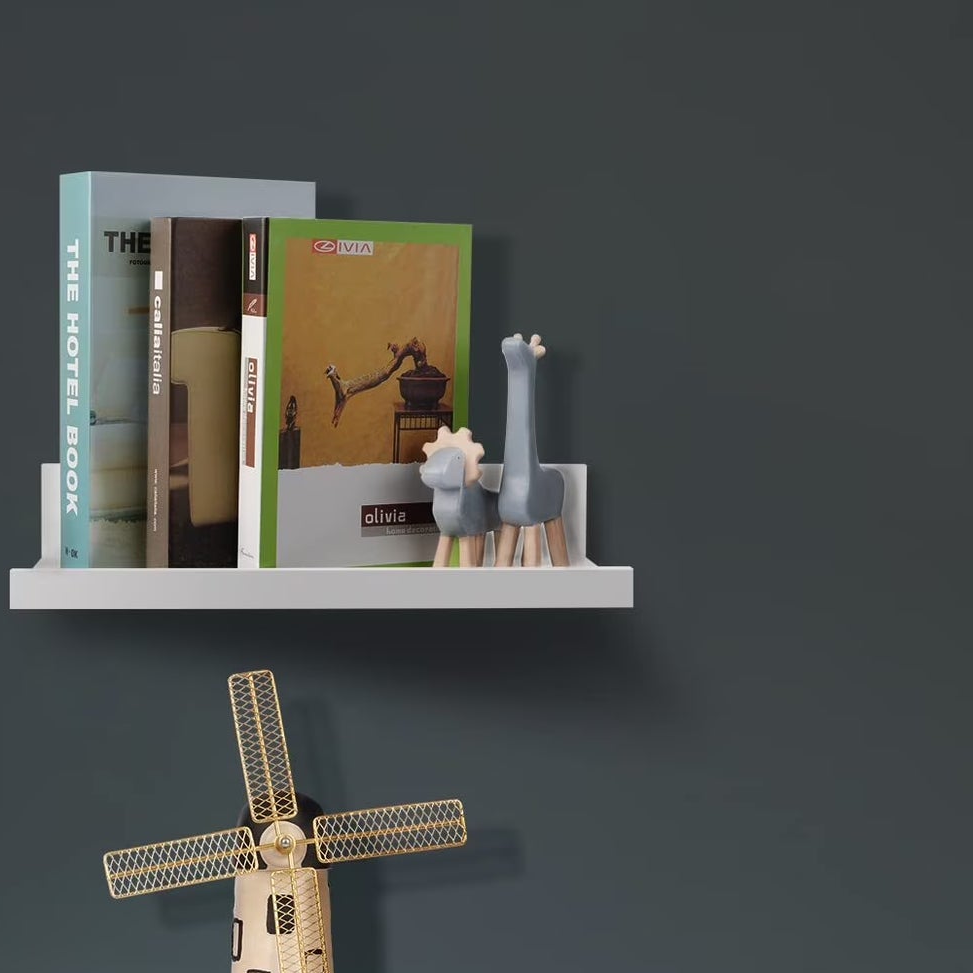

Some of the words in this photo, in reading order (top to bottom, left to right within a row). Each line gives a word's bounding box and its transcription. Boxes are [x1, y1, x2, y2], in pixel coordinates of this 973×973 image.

[67, 239, 79, 302] THE
[104, 231, 151, 253] THE
[67, 313, 79, 415] HOTEL
[246, 361, 257, 414] olivia
[66, 425, 79, 517] BOOK
[364, 507, 406, 524] olivia
